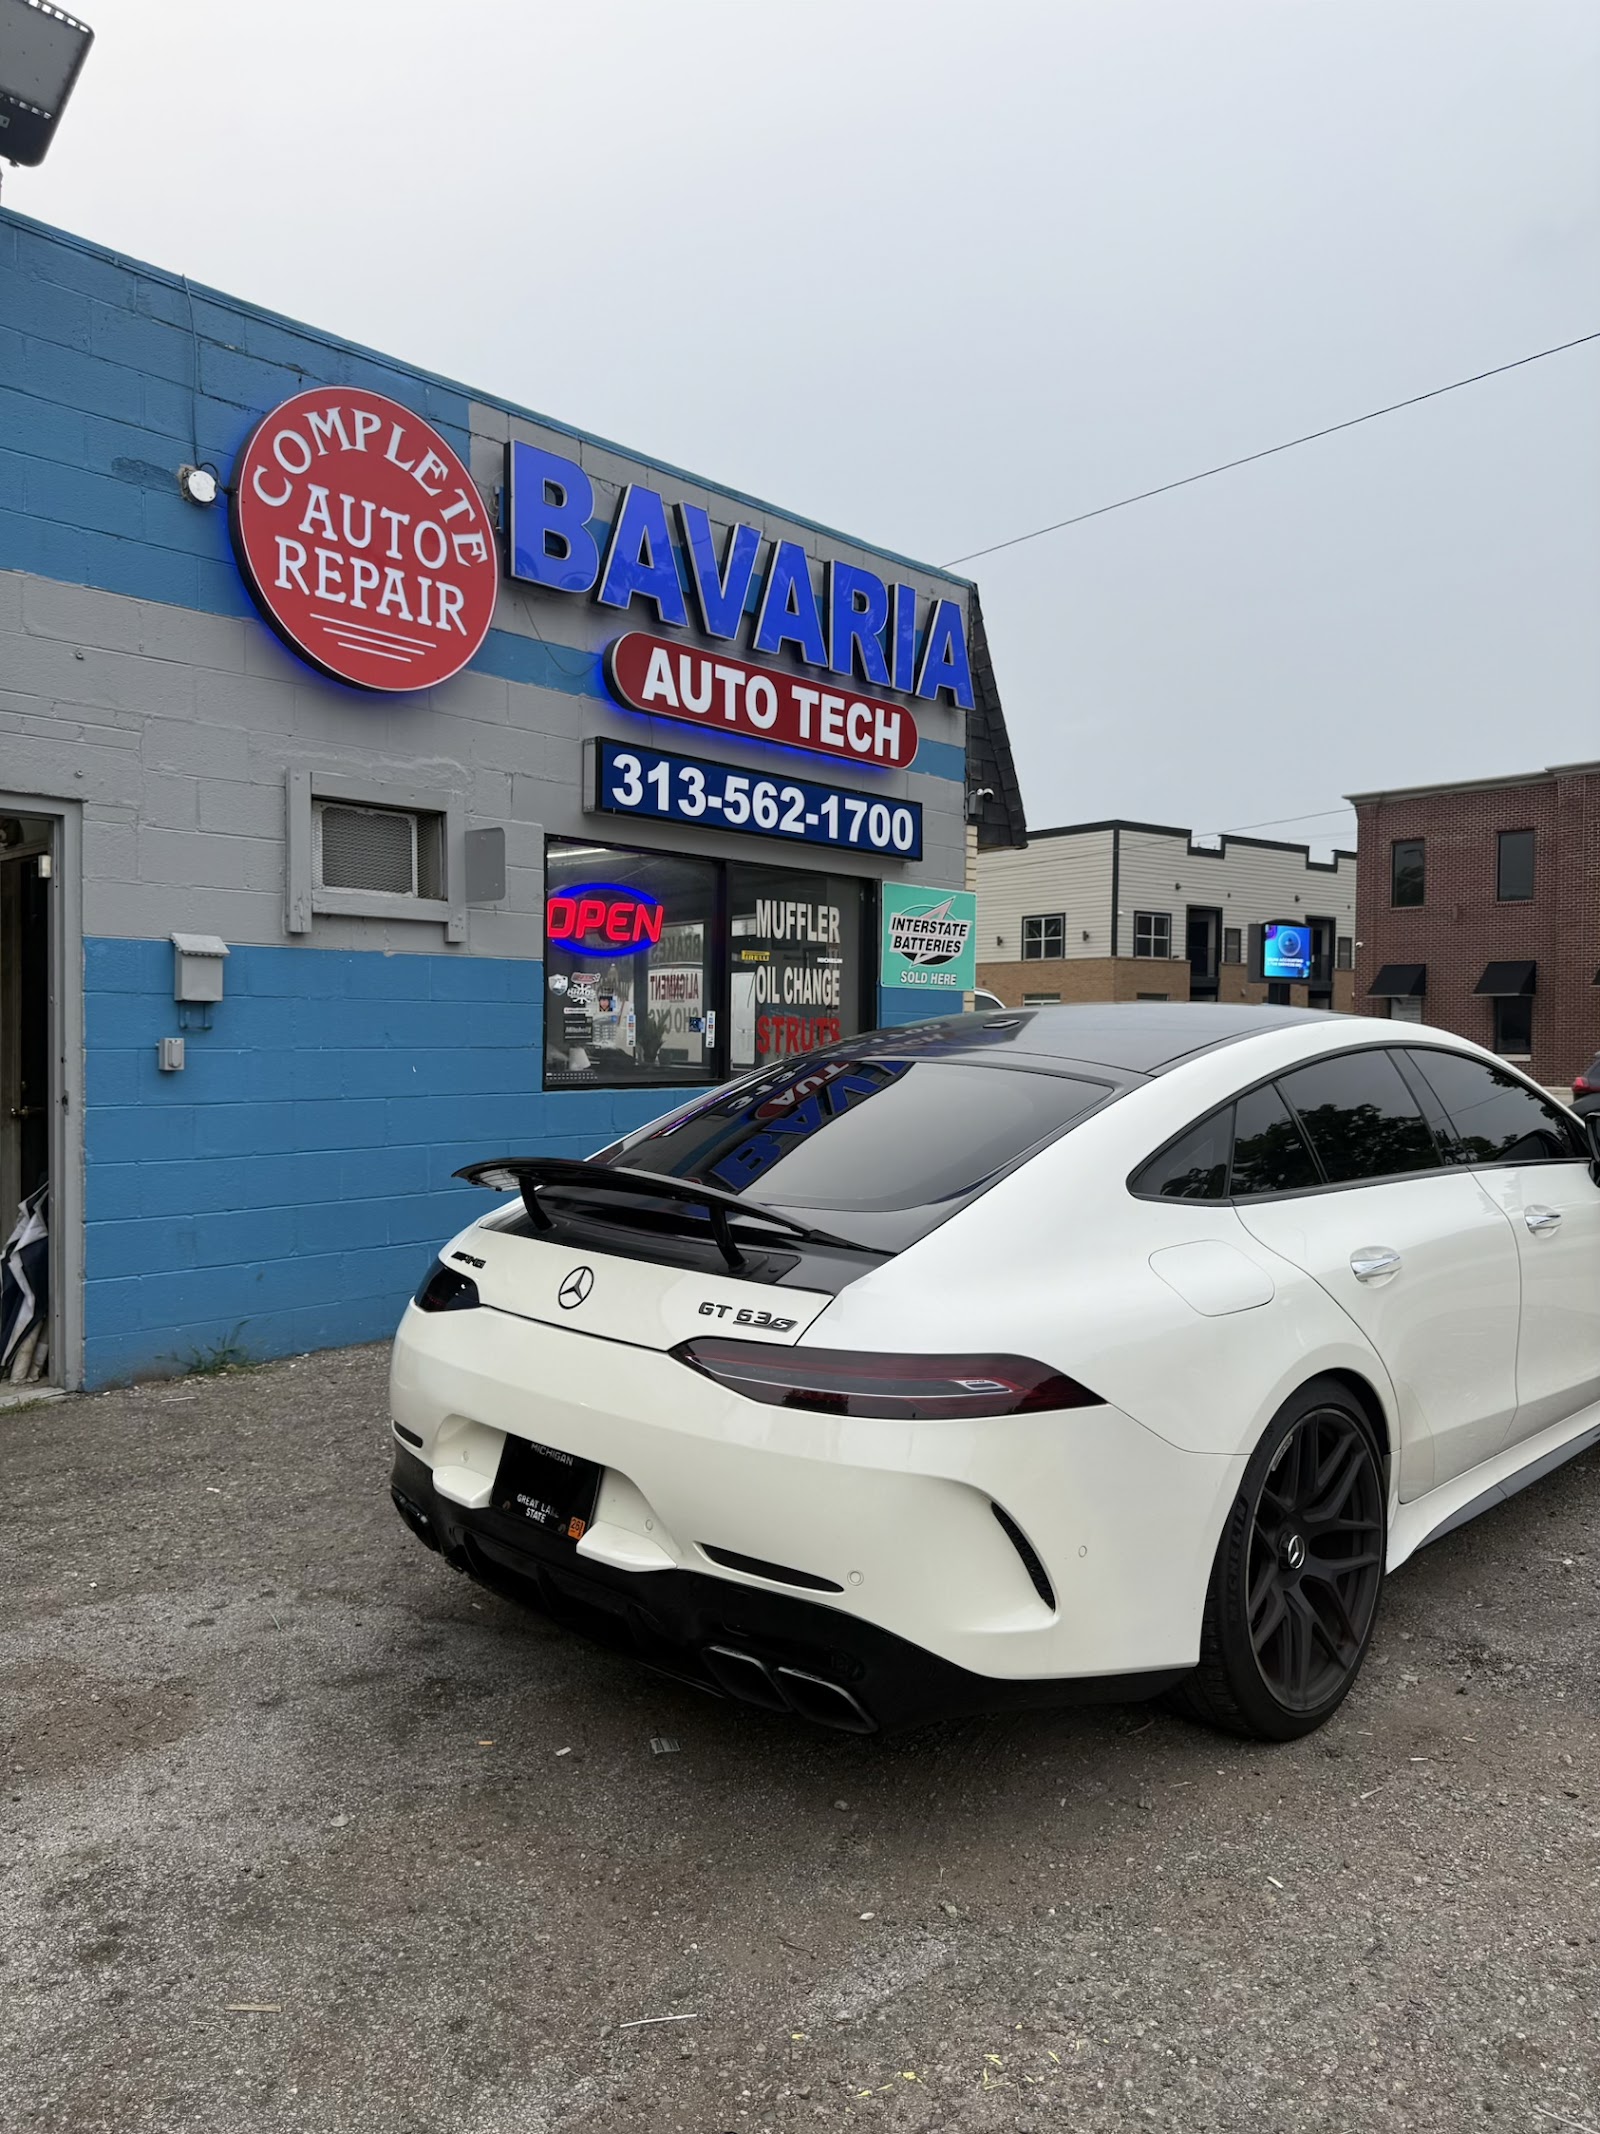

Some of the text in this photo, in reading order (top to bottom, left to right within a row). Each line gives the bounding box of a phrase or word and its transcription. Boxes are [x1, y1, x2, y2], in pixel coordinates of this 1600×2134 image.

[252, 407, 488, 567] COMPLETE
[298, 483, 448, 569] AUTO
[274, 535, 468, 636] REPAIR
[507, 439, 976, 711] BAVARIA
[641, 646, 901, 761] AUTO TECH
[611, 753, 914, 851] 313-562-1700
[547, 897, 664, 943] OPEN
[756, 899, 841, 943] MUFFLER
[892, 917, 968, 937] INTERSTATE
[893, 935, 961, 954] BATTERIES
[755, 965, 841, 1006] OIL CHANGE
[900, 970, 957, 985] SOLD HERE
[756, 1015, 842, 1055] STRUTS
[698, 1301, 733, 1318] GT
[531, 1443, 574, 1466] MICHIGAN
[517, 1493, 539, 1509] GREAT
[525, 1507, 547, 1524] STATE
